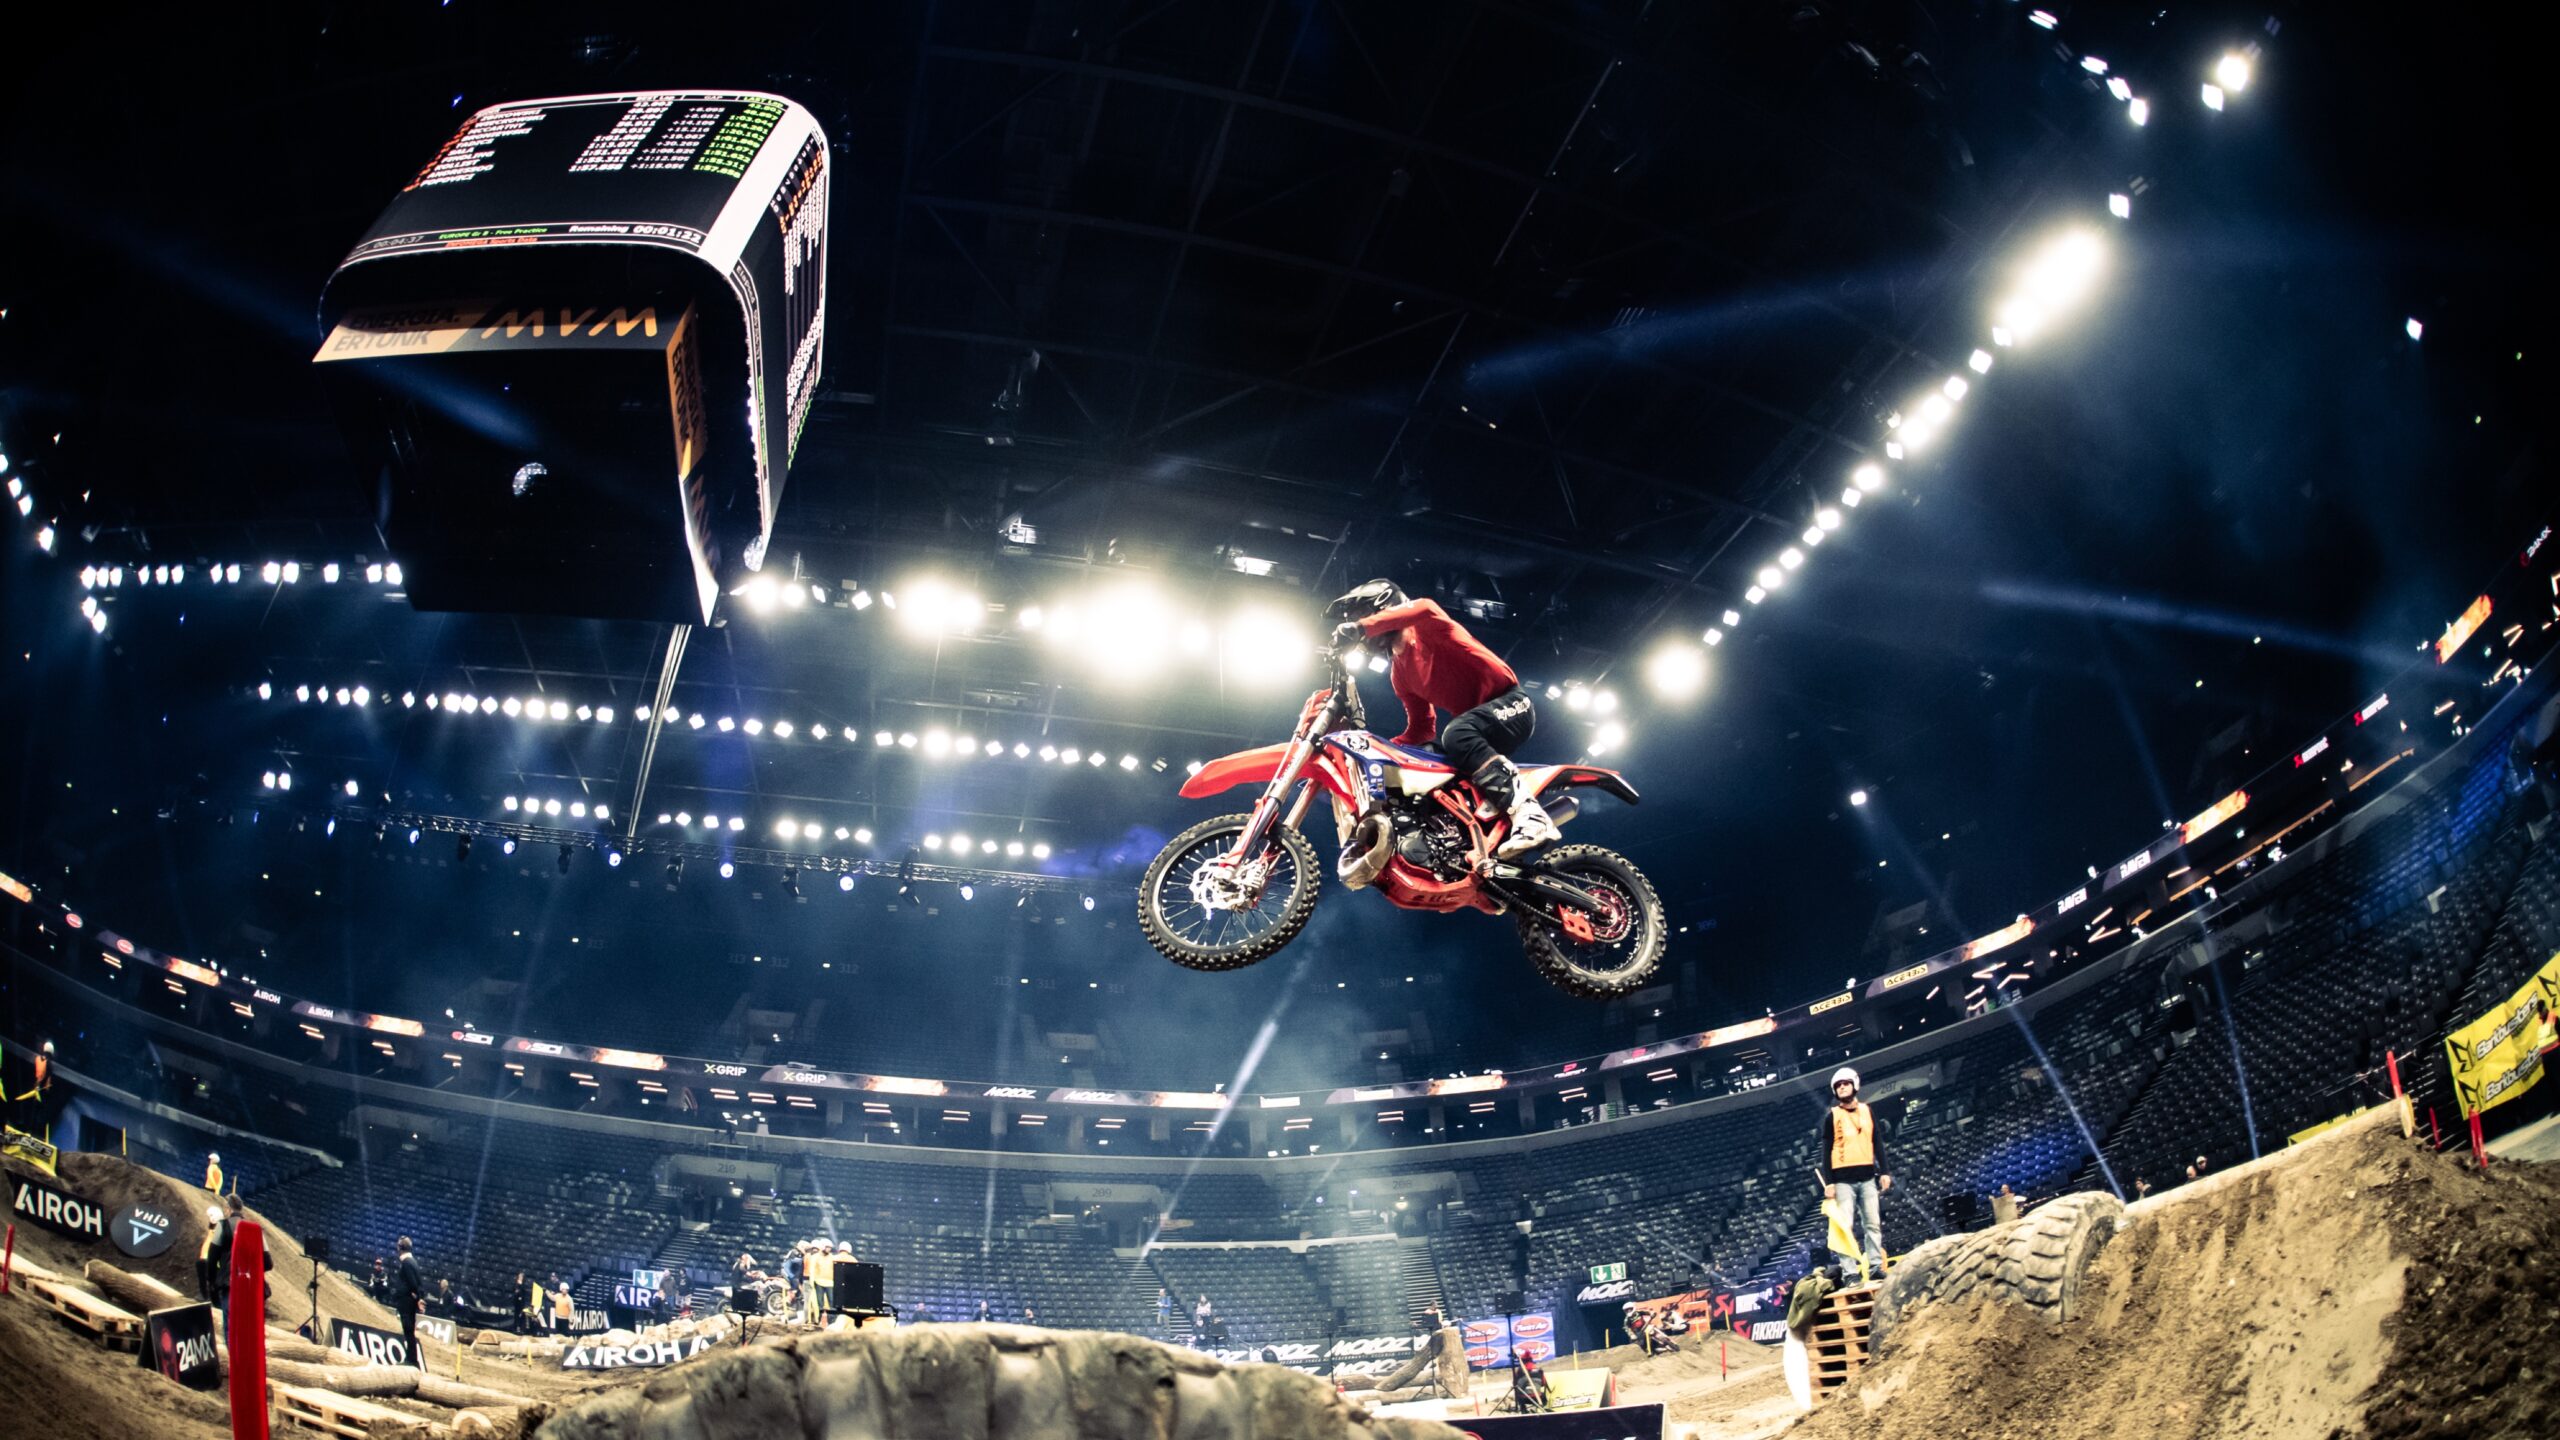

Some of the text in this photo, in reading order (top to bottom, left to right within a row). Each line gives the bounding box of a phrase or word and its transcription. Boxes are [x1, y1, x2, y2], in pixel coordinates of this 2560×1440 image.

[438, 231, 470, 240] EUROPE
[569, 225, 630, 233] Remaining
[633, 225, 702, 243] 00:01:22
[481, 306, 658, 339] MVM
[253, 989, 281, 1004] AIROH
[308, 1006, 334, 1018] AIROH
[2476, 990, 2538, 1060] Barkbusters
[704, 1063, 747, 1076] X-GRIP
[783, 1071, 827, 1083] X-GRIP
[14, 1183, 103, 1236] AIROH
[1536, 1322, 1548, 1330] Air
[176, 1333, 215, 1372] 24MX
[563, 1339, 682, 1367] AIROH
